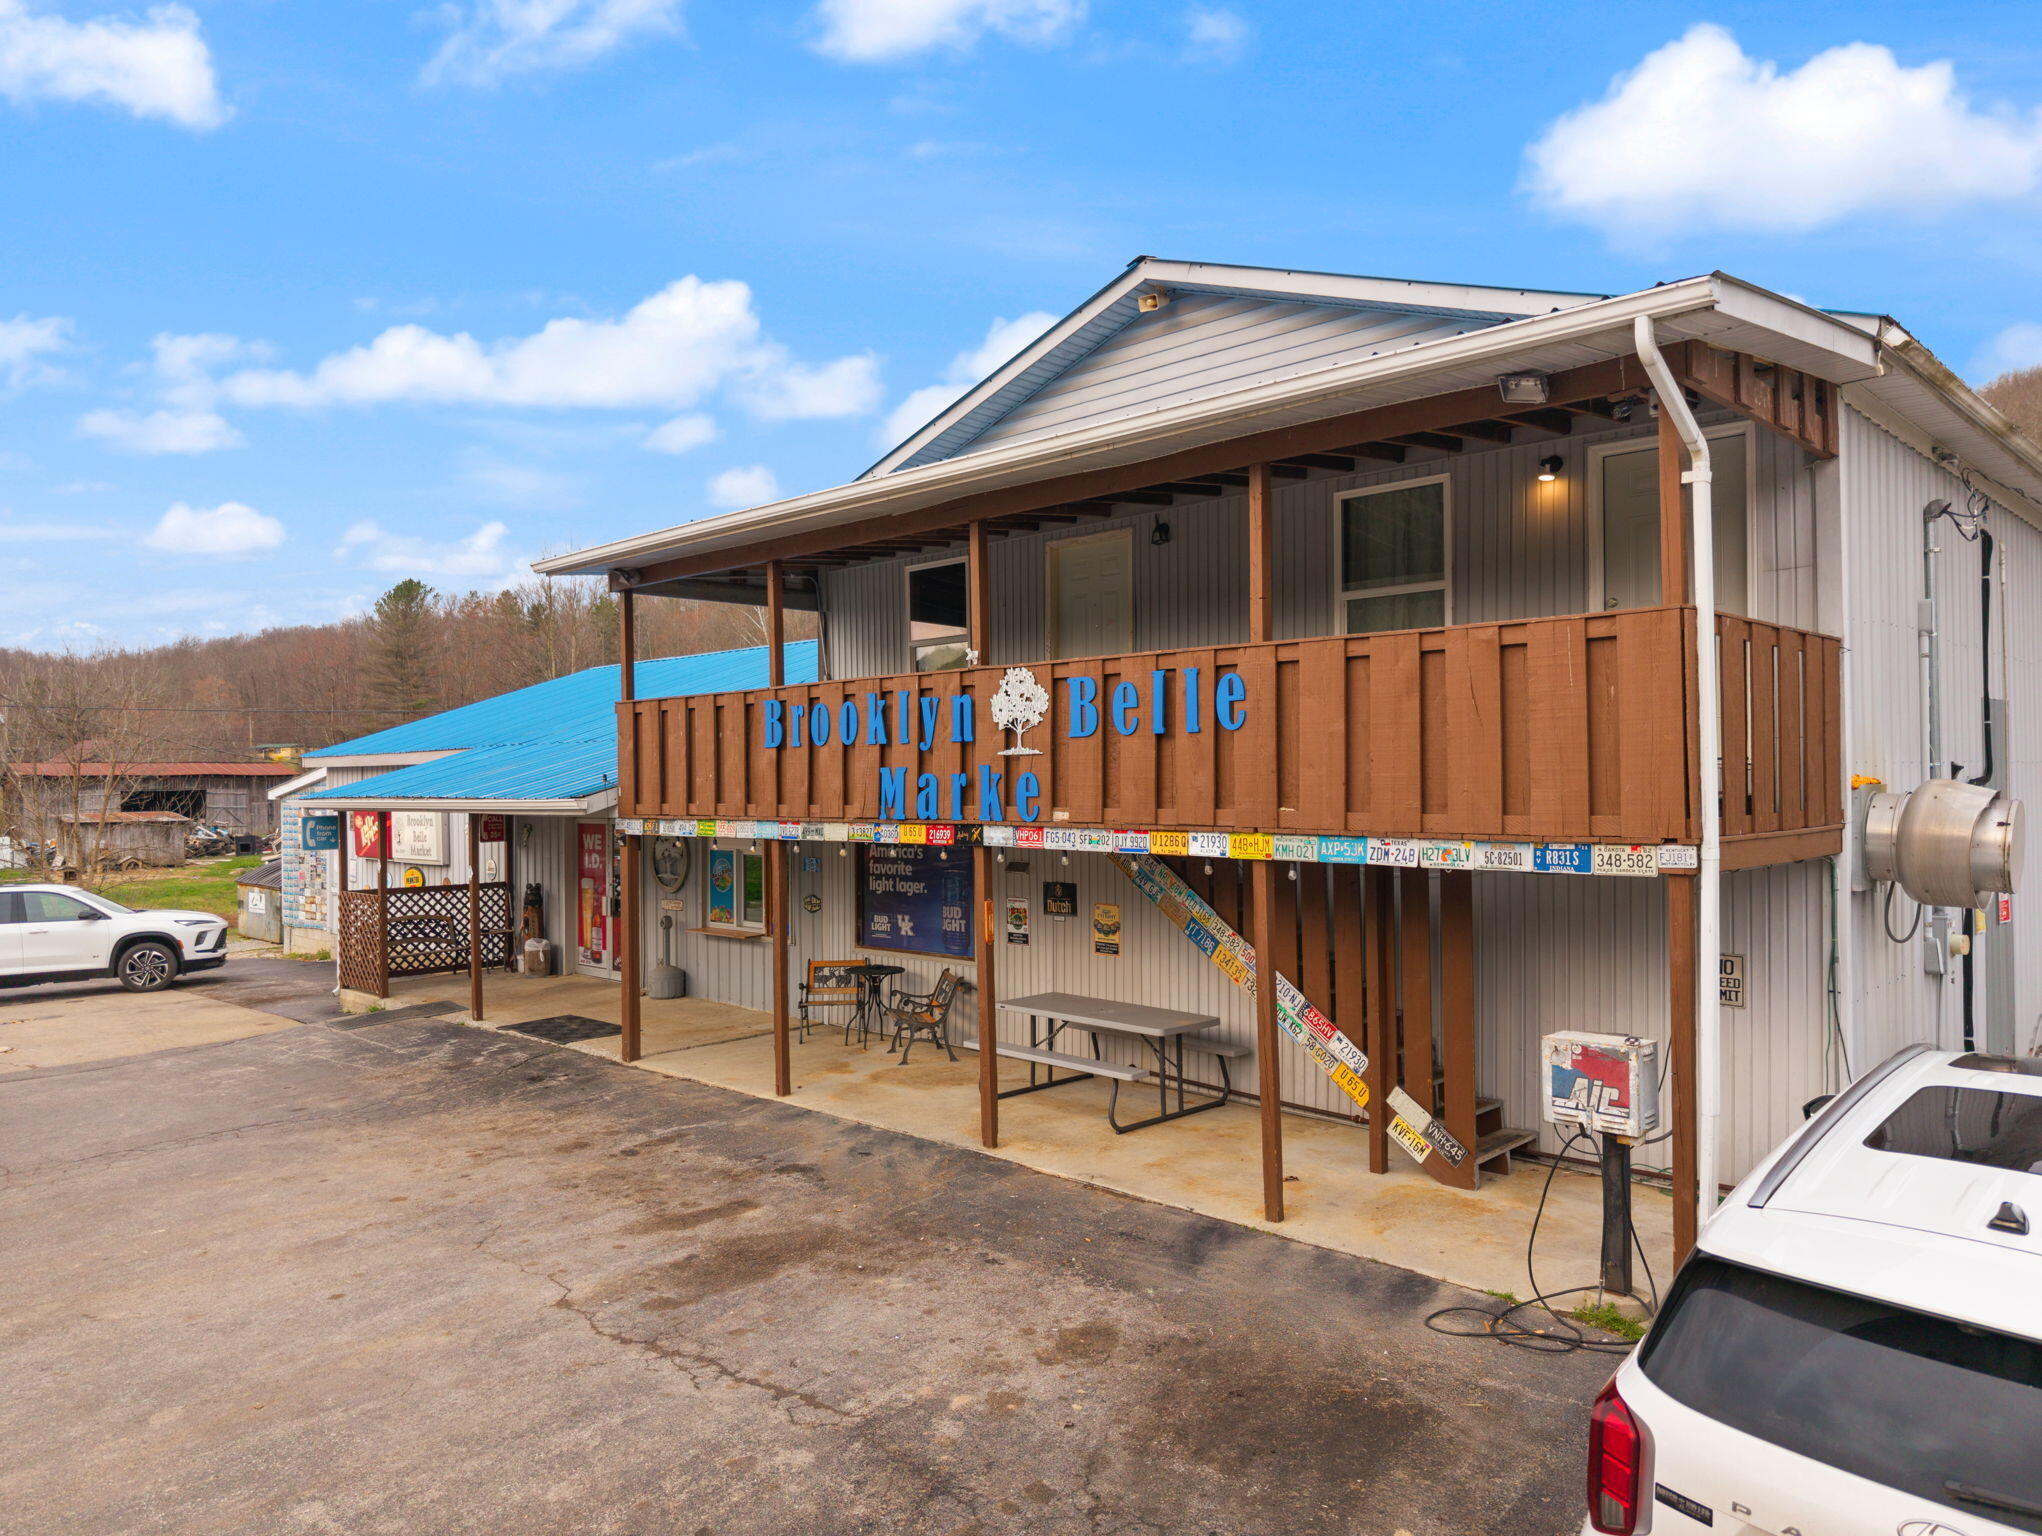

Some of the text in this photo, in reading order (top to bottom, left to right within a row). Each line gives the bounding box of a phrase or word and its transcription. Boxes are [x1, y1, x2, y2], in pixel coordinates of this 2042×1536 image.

[763, 667, 1247, 752] Brooklyn Belle
[879, 764, 1041, 822] Marke
[406, 814, 434, 829] Brooklyn
[413, 831, 428, 843] Belle
[582, 833, 602, 850] WE
[929, 829, 951, 840] 216939
[1016, 827, 1043, 842] VHP061
[1200, 834, 1227, 849] 21930
[410, 845, 432, 857] Market
[1484, 850, 1523, 866] 5C-82501
[585, 853, 603, 870] I.D.
[869, 860, 913, 876] favorite
[869, 877, 928, 896] light lager.
[943, 905, 962, 919] BUD
[1047, 899, 1072, 913] Dutch
[873, 914, 889, 923] BUD
[871, 922, 892, 932] LIGHT
[1720, 977, 1741, 989] EED
[1720, 989, 1741, 1002] MIT
[1303, 1008, 1335, 1038] 6865HV
[1340, 1042, 1367, 1070] 21930
[1346, 1076, 1360, 1091] 65
[1553, 1077, 1629, 1118] Air
